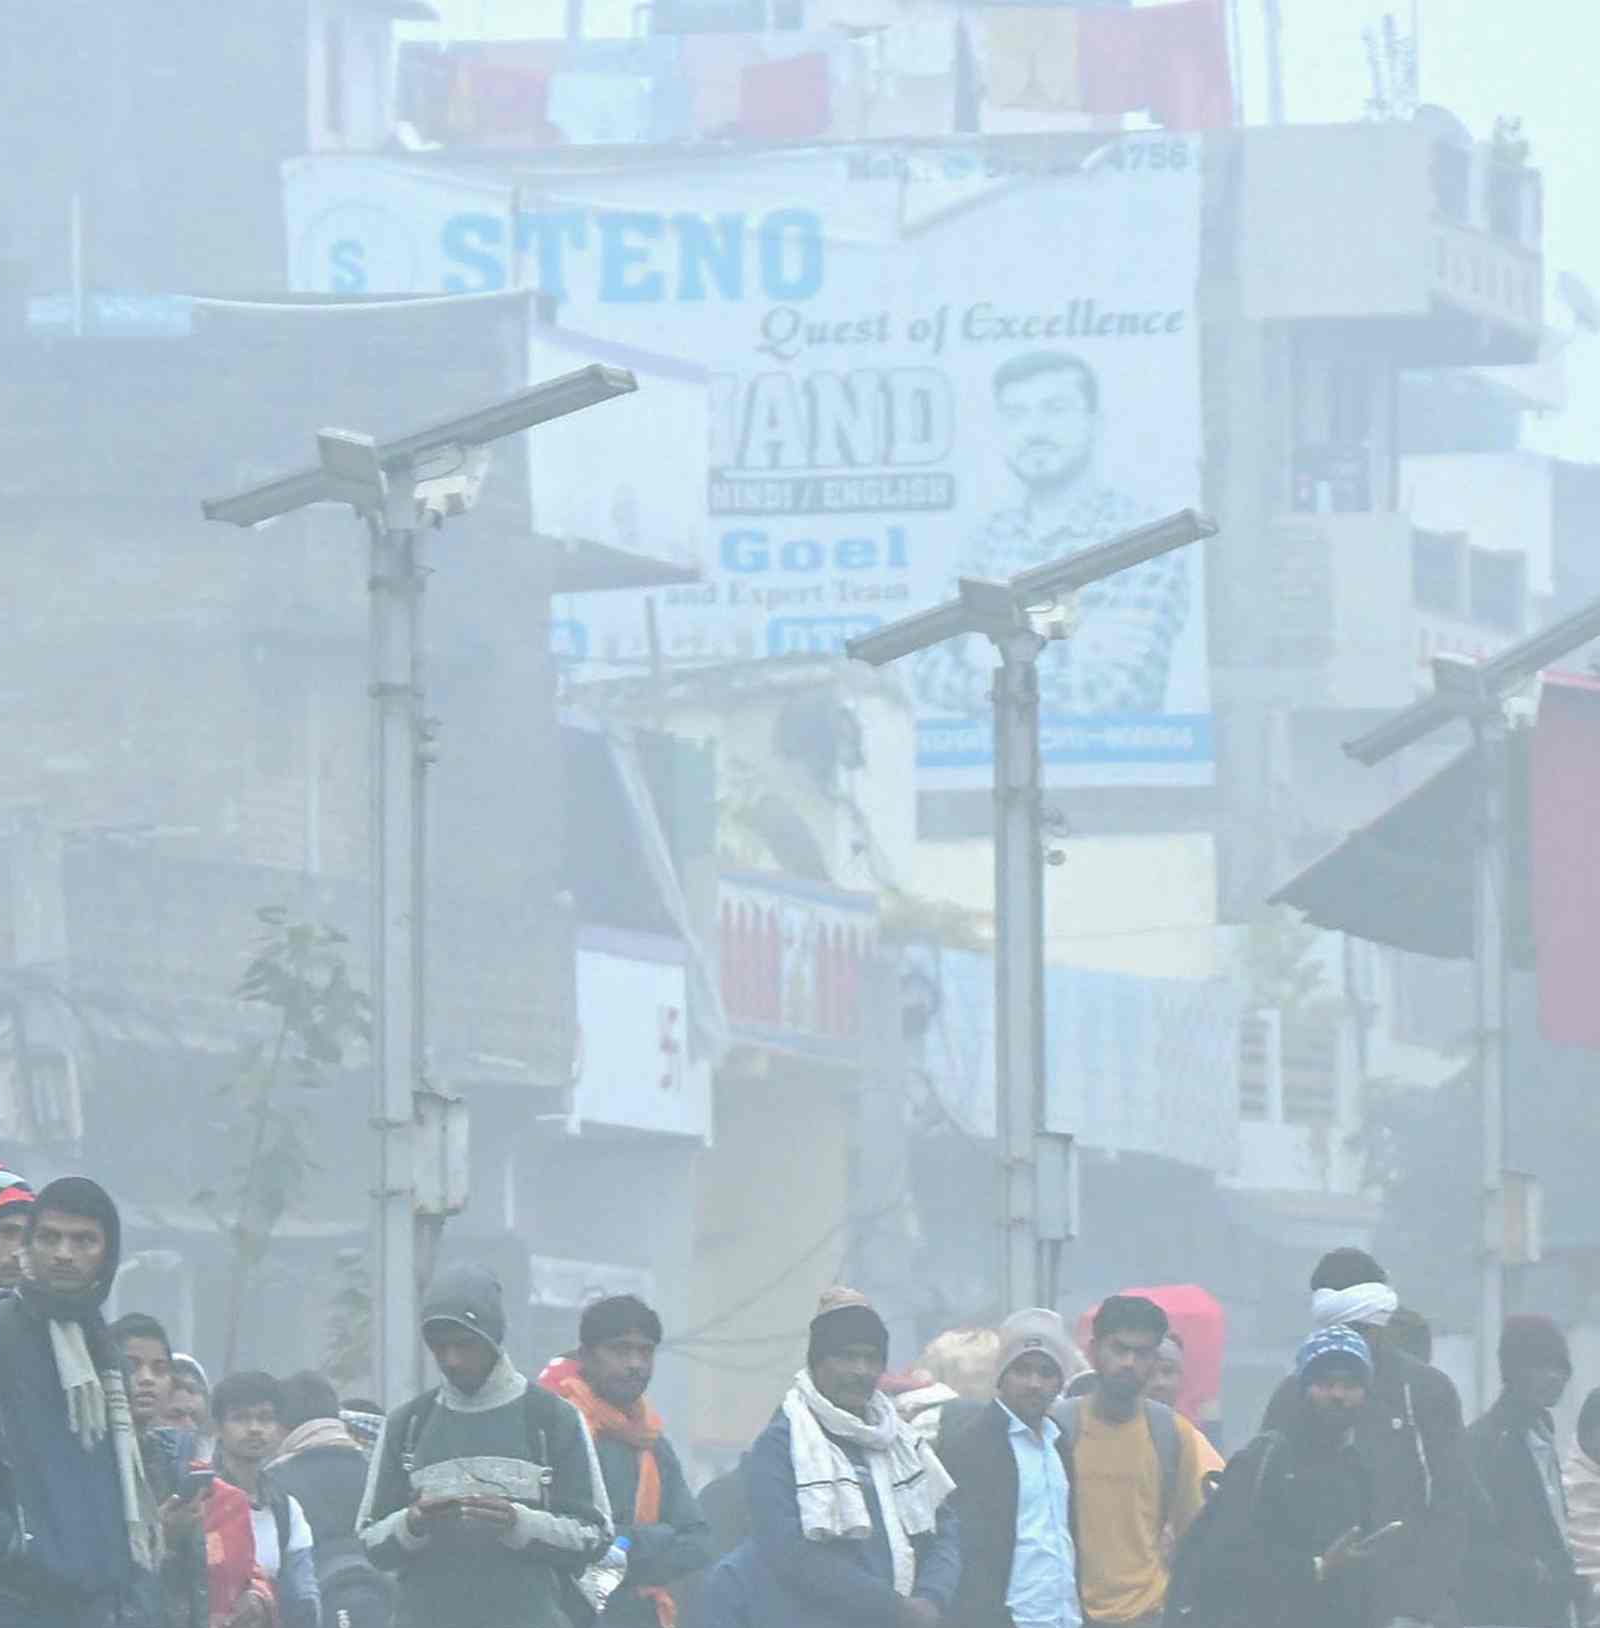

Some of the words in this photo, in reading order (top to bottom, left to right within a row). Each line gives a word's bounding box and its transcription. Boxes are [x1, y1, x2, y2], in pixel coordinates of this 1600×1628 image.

[441, 208, 827, 303] STENO
[755, 306, 891, 357] Quest
[908, 303, 949, 354] of
[961, 298, 1185, 343] Excellence
[708, 366, 956, 468] AND
[712, 481, 792, 511] HINDI
[822, 476, 949, 508] ENGLISH
[720, 526, 908, 574] Goel
